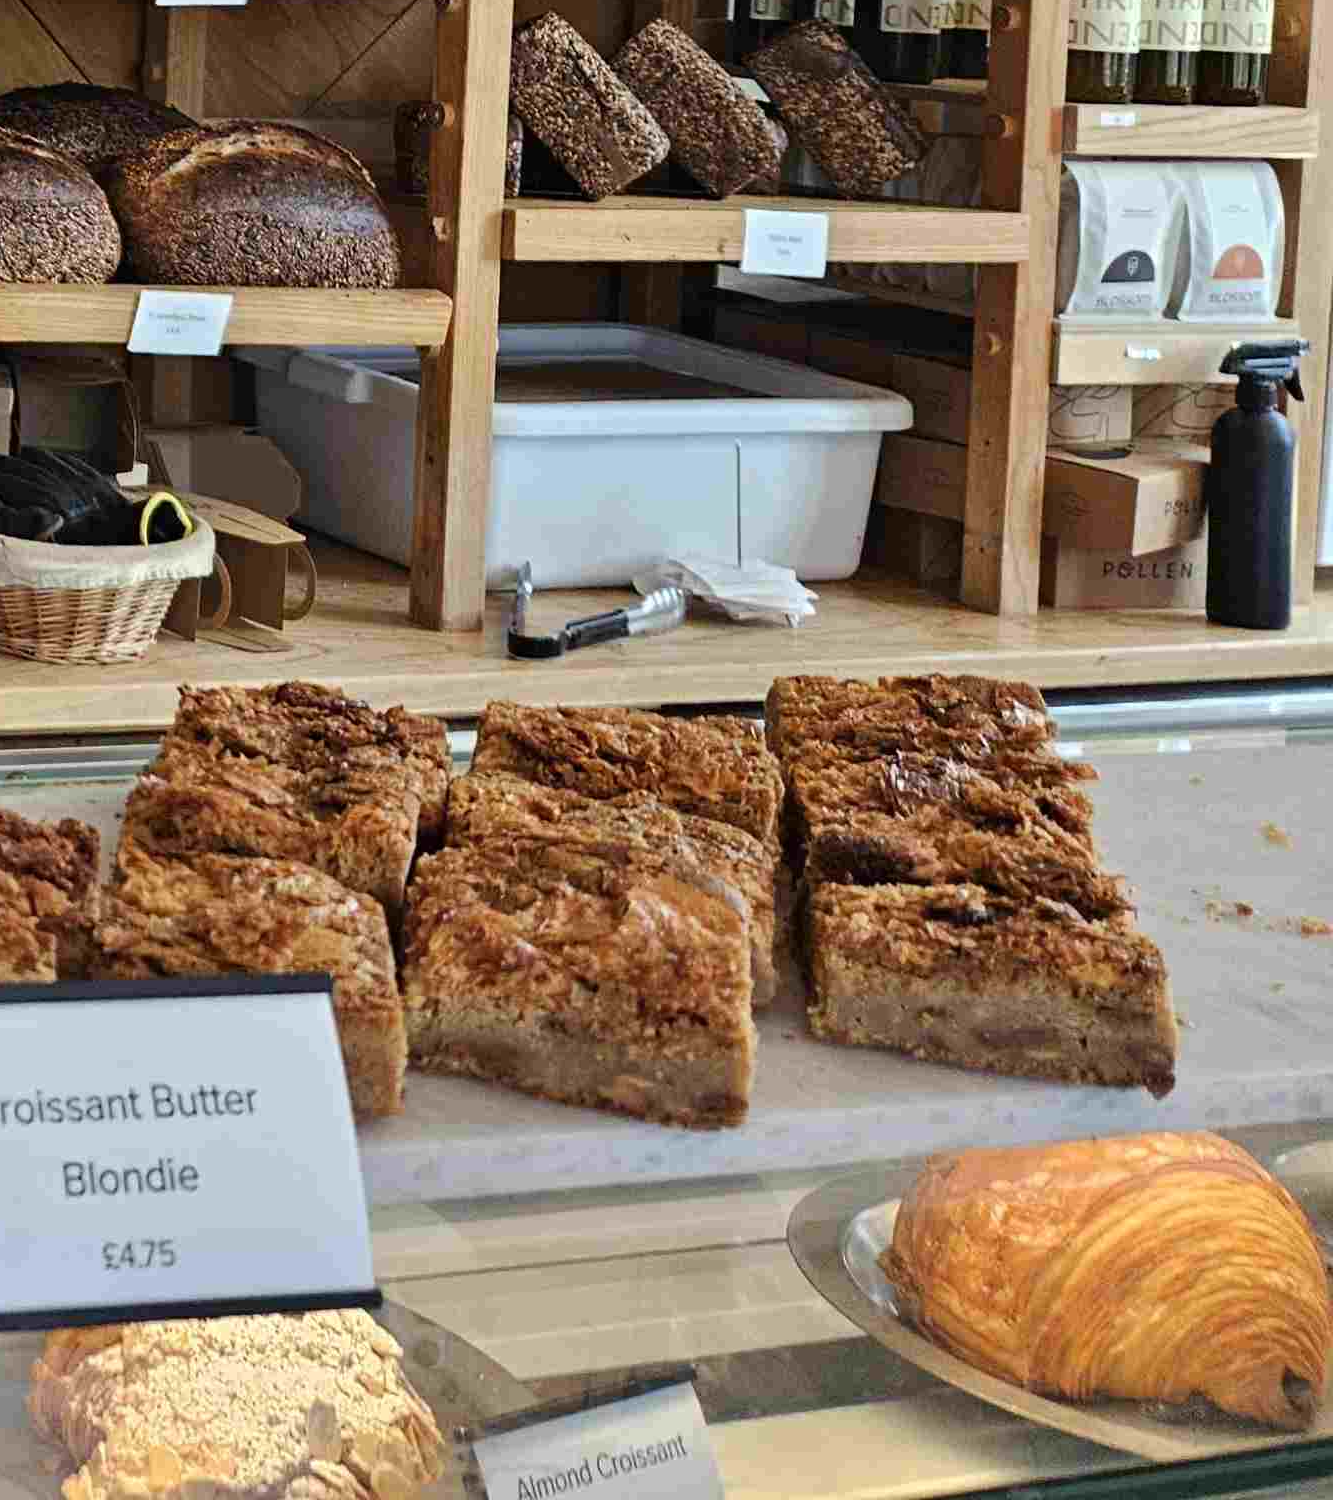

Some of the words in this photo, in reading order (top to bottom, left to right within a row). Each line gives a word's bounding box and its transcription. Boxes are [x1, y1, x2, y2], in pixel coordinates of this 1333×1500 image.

[1102, 560, 1194, 580] POLLEN
[152, 1083, 259, 1119] Butter
[62, 1158, 200, 1197] Blondie
[101, 1238, 177, 1271] £4.75
[517, 1459, 594, 1500] Almond
[595, 1432, 689, 1479] Croissant
